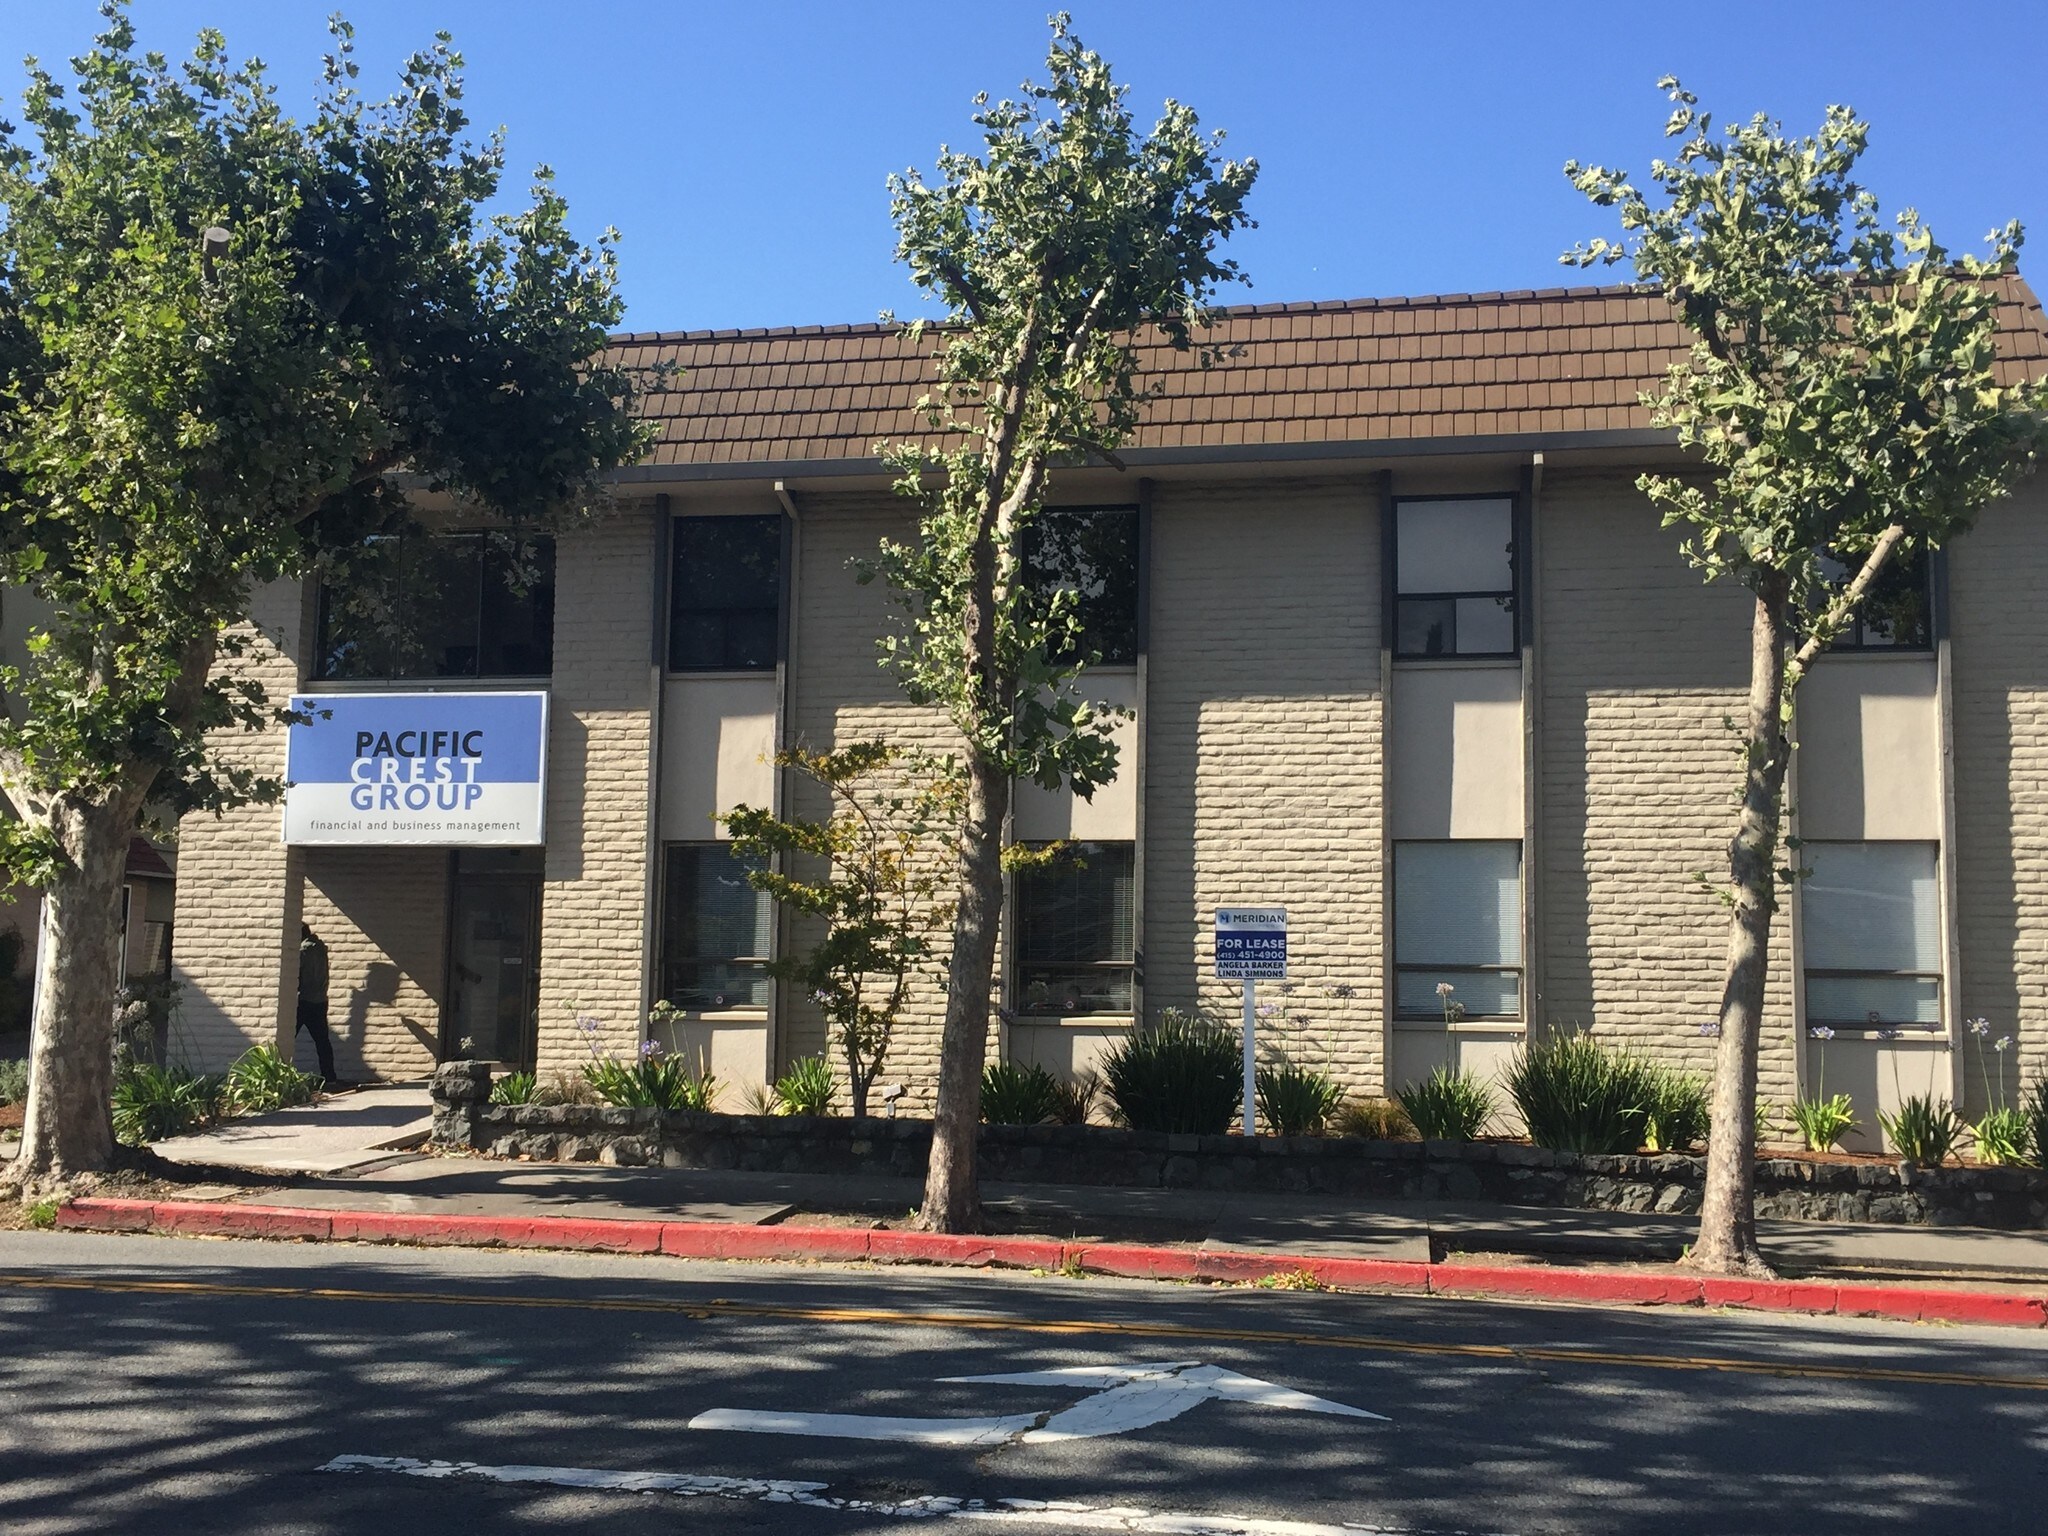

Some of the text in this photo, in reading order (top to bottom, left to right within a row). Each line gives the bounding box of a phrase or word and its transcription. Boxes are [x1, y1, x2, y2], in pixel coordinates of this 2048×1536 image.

[355, 730, 484, 758] PACIFIC
[350, 757, 483, 784] CREST
[350, 783, 483, 811] GROUP
[310, 820, 521, 833] financial and business management
[1233, 914, 1284, 923] MERIDIAN
[1217, 939, 1285, 949] FOR LEASE
[1238, 951, 1284, 959] 451-4900
